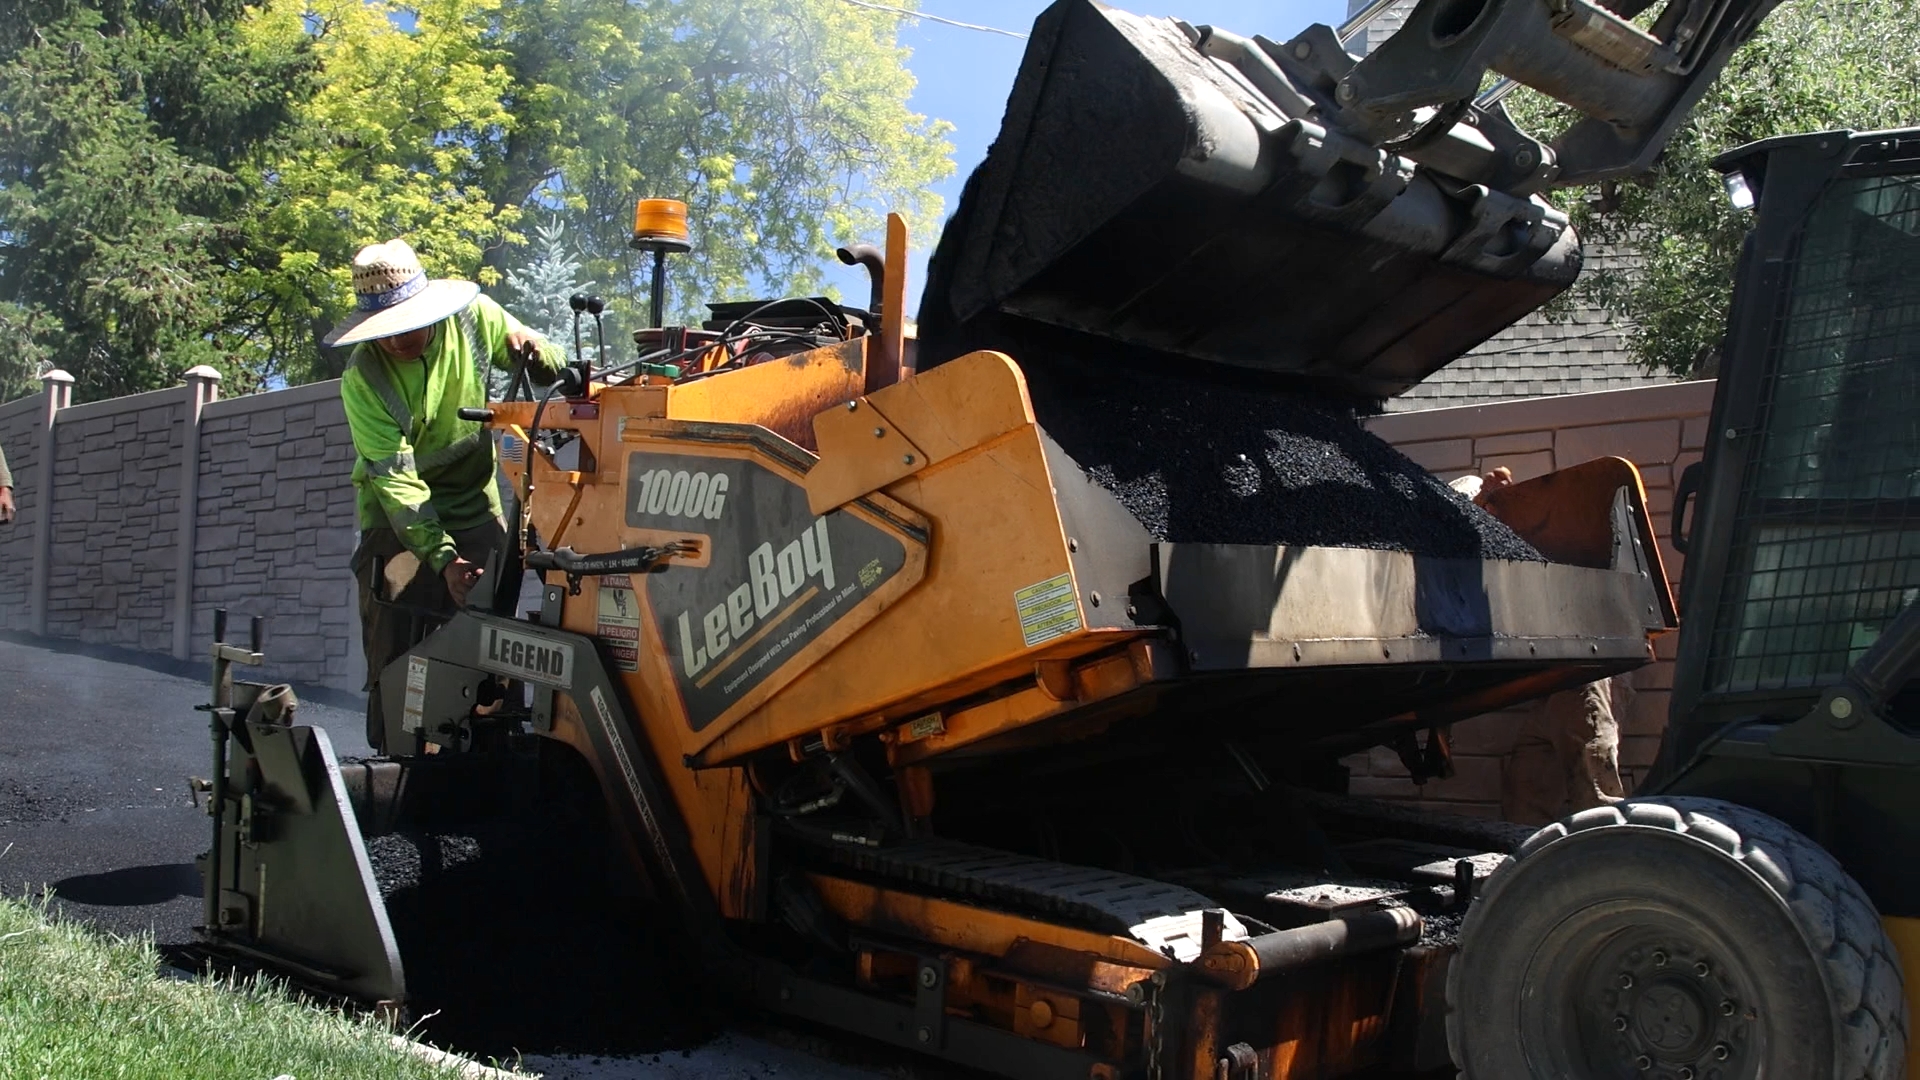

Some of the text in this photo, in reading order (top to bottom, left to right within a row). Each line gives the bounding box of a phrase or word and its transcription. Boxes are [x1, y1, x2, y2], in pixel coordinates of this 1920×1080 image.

[637, 469, 729, 519] 1000G
[609, 576, 630, 587] DANG
[678, 515, 835, 679] LeeBoy
[1031, 583, 1053, 594] CAUTION
[488, 629, 564, 676] LEGEND
[606, 627, 637, 639] PELIGRO
[724, 670, 748, 694] Equipment
[747, 652, 770, 675] Designed
[788, 624, 807, 641] Paving
[805, 597, 837, 628] Professional
